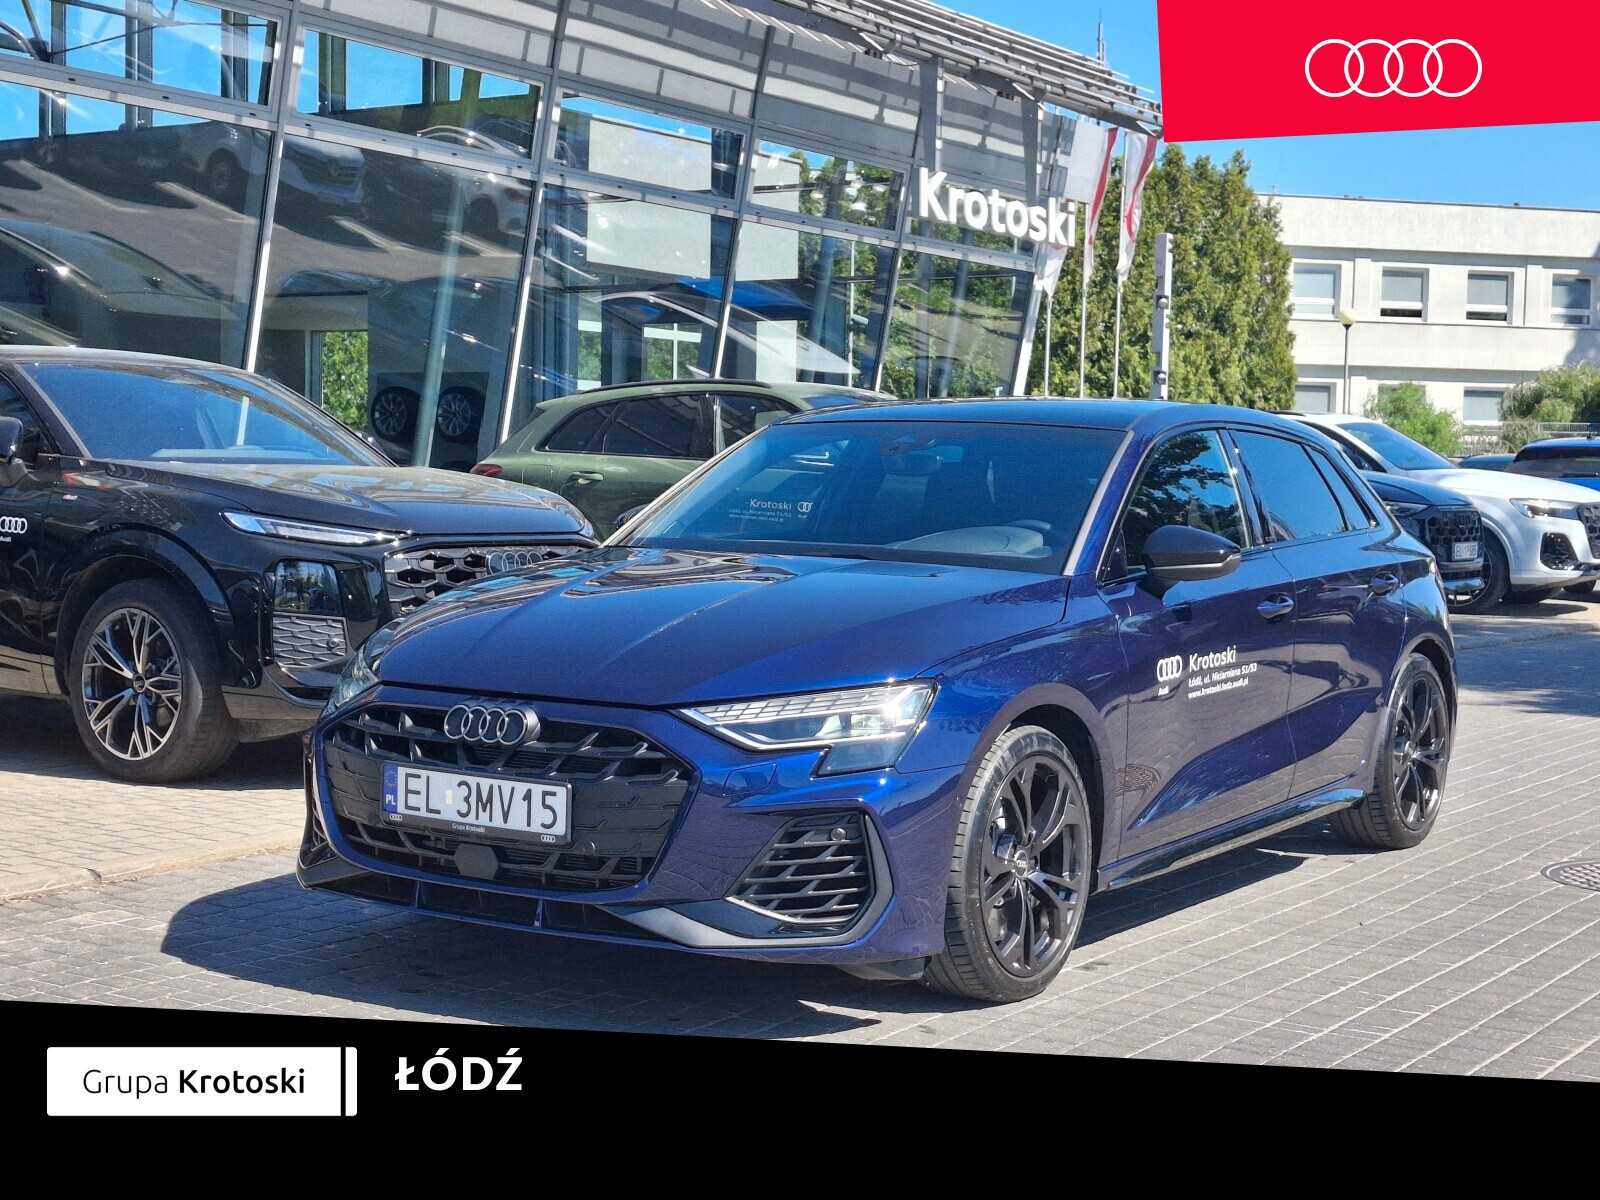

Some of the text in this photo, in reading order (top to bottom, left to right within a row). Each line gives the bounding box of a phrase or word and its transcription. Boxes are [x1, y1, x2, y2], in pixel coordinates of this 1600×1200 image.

[919, 167, 1075, 247] Krotoski
[749, 498, 792, 510] Krotoski
[1189, 645, 1236, 672] Krotoski
[1241, 662, 1257, 675] 51/53
[385, 794, 396, 806] PL
[404, 772, 558, 829] EL 3MV15
